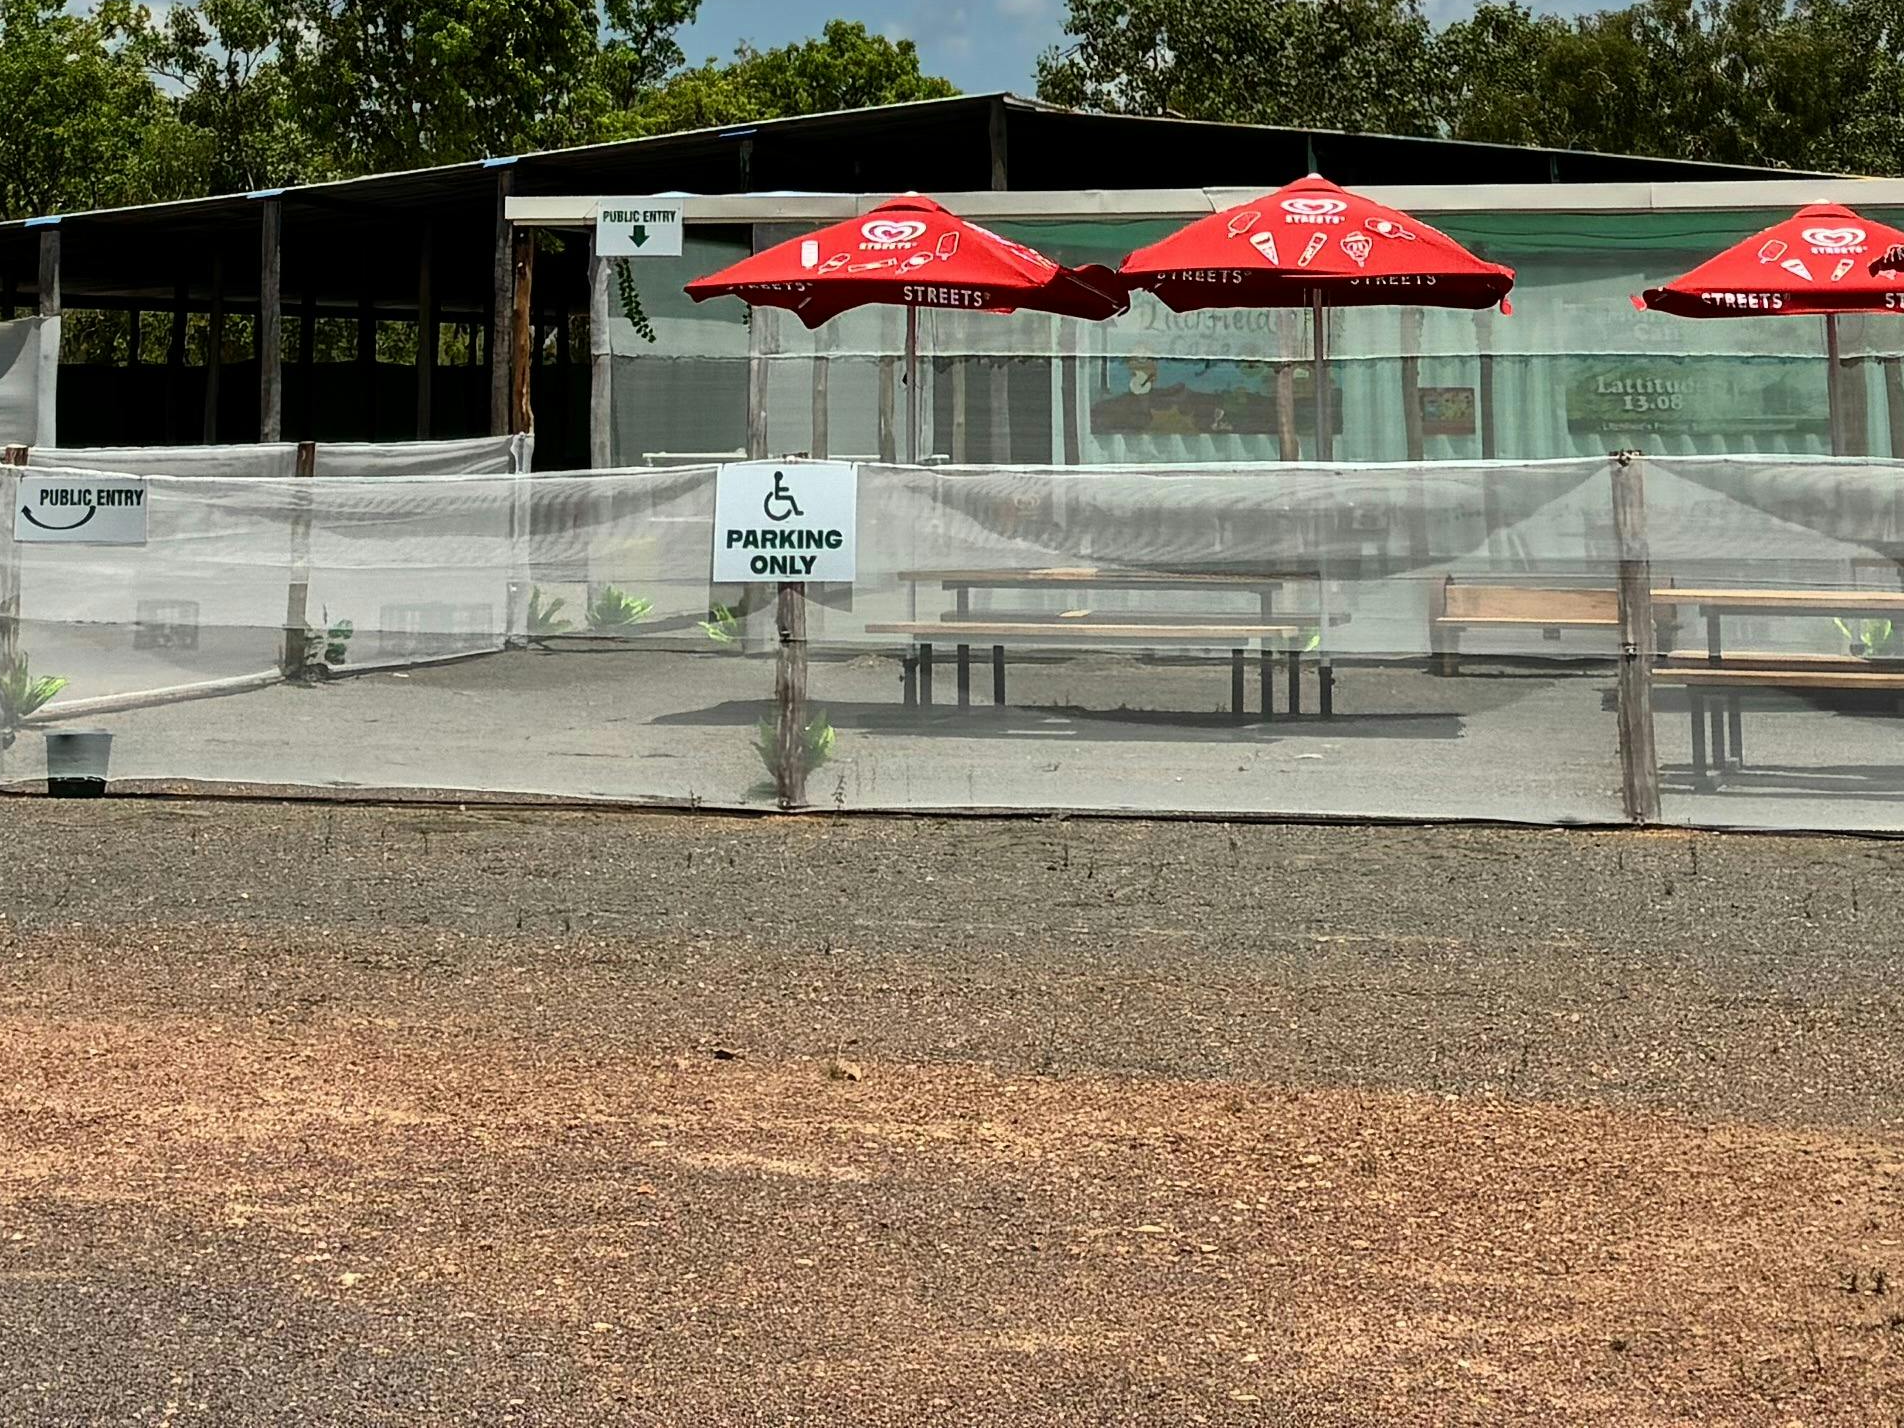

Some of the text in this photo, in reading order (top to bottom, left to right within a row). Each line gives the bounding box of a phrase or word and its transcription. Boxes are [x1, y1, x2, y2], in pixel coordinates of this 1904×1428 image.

[603, 210, 676, 223] PUBLIC ENTRY
[1286, 215, 1340, 224] STREETS
[1157, 270, 1243, 284] STREETS
[728, 282, 806, 291] REETS
[904, 285, 982, 306] STREETS
[1701, 293, 1783, 309] STREETS
[1623, 394, 1684, 412] 13.08
[40, 489, 144, 506] PUBLIC ENTRY
[726, 529, 843, 549] PARKING
[750, 555, 817, 574] ONLY
